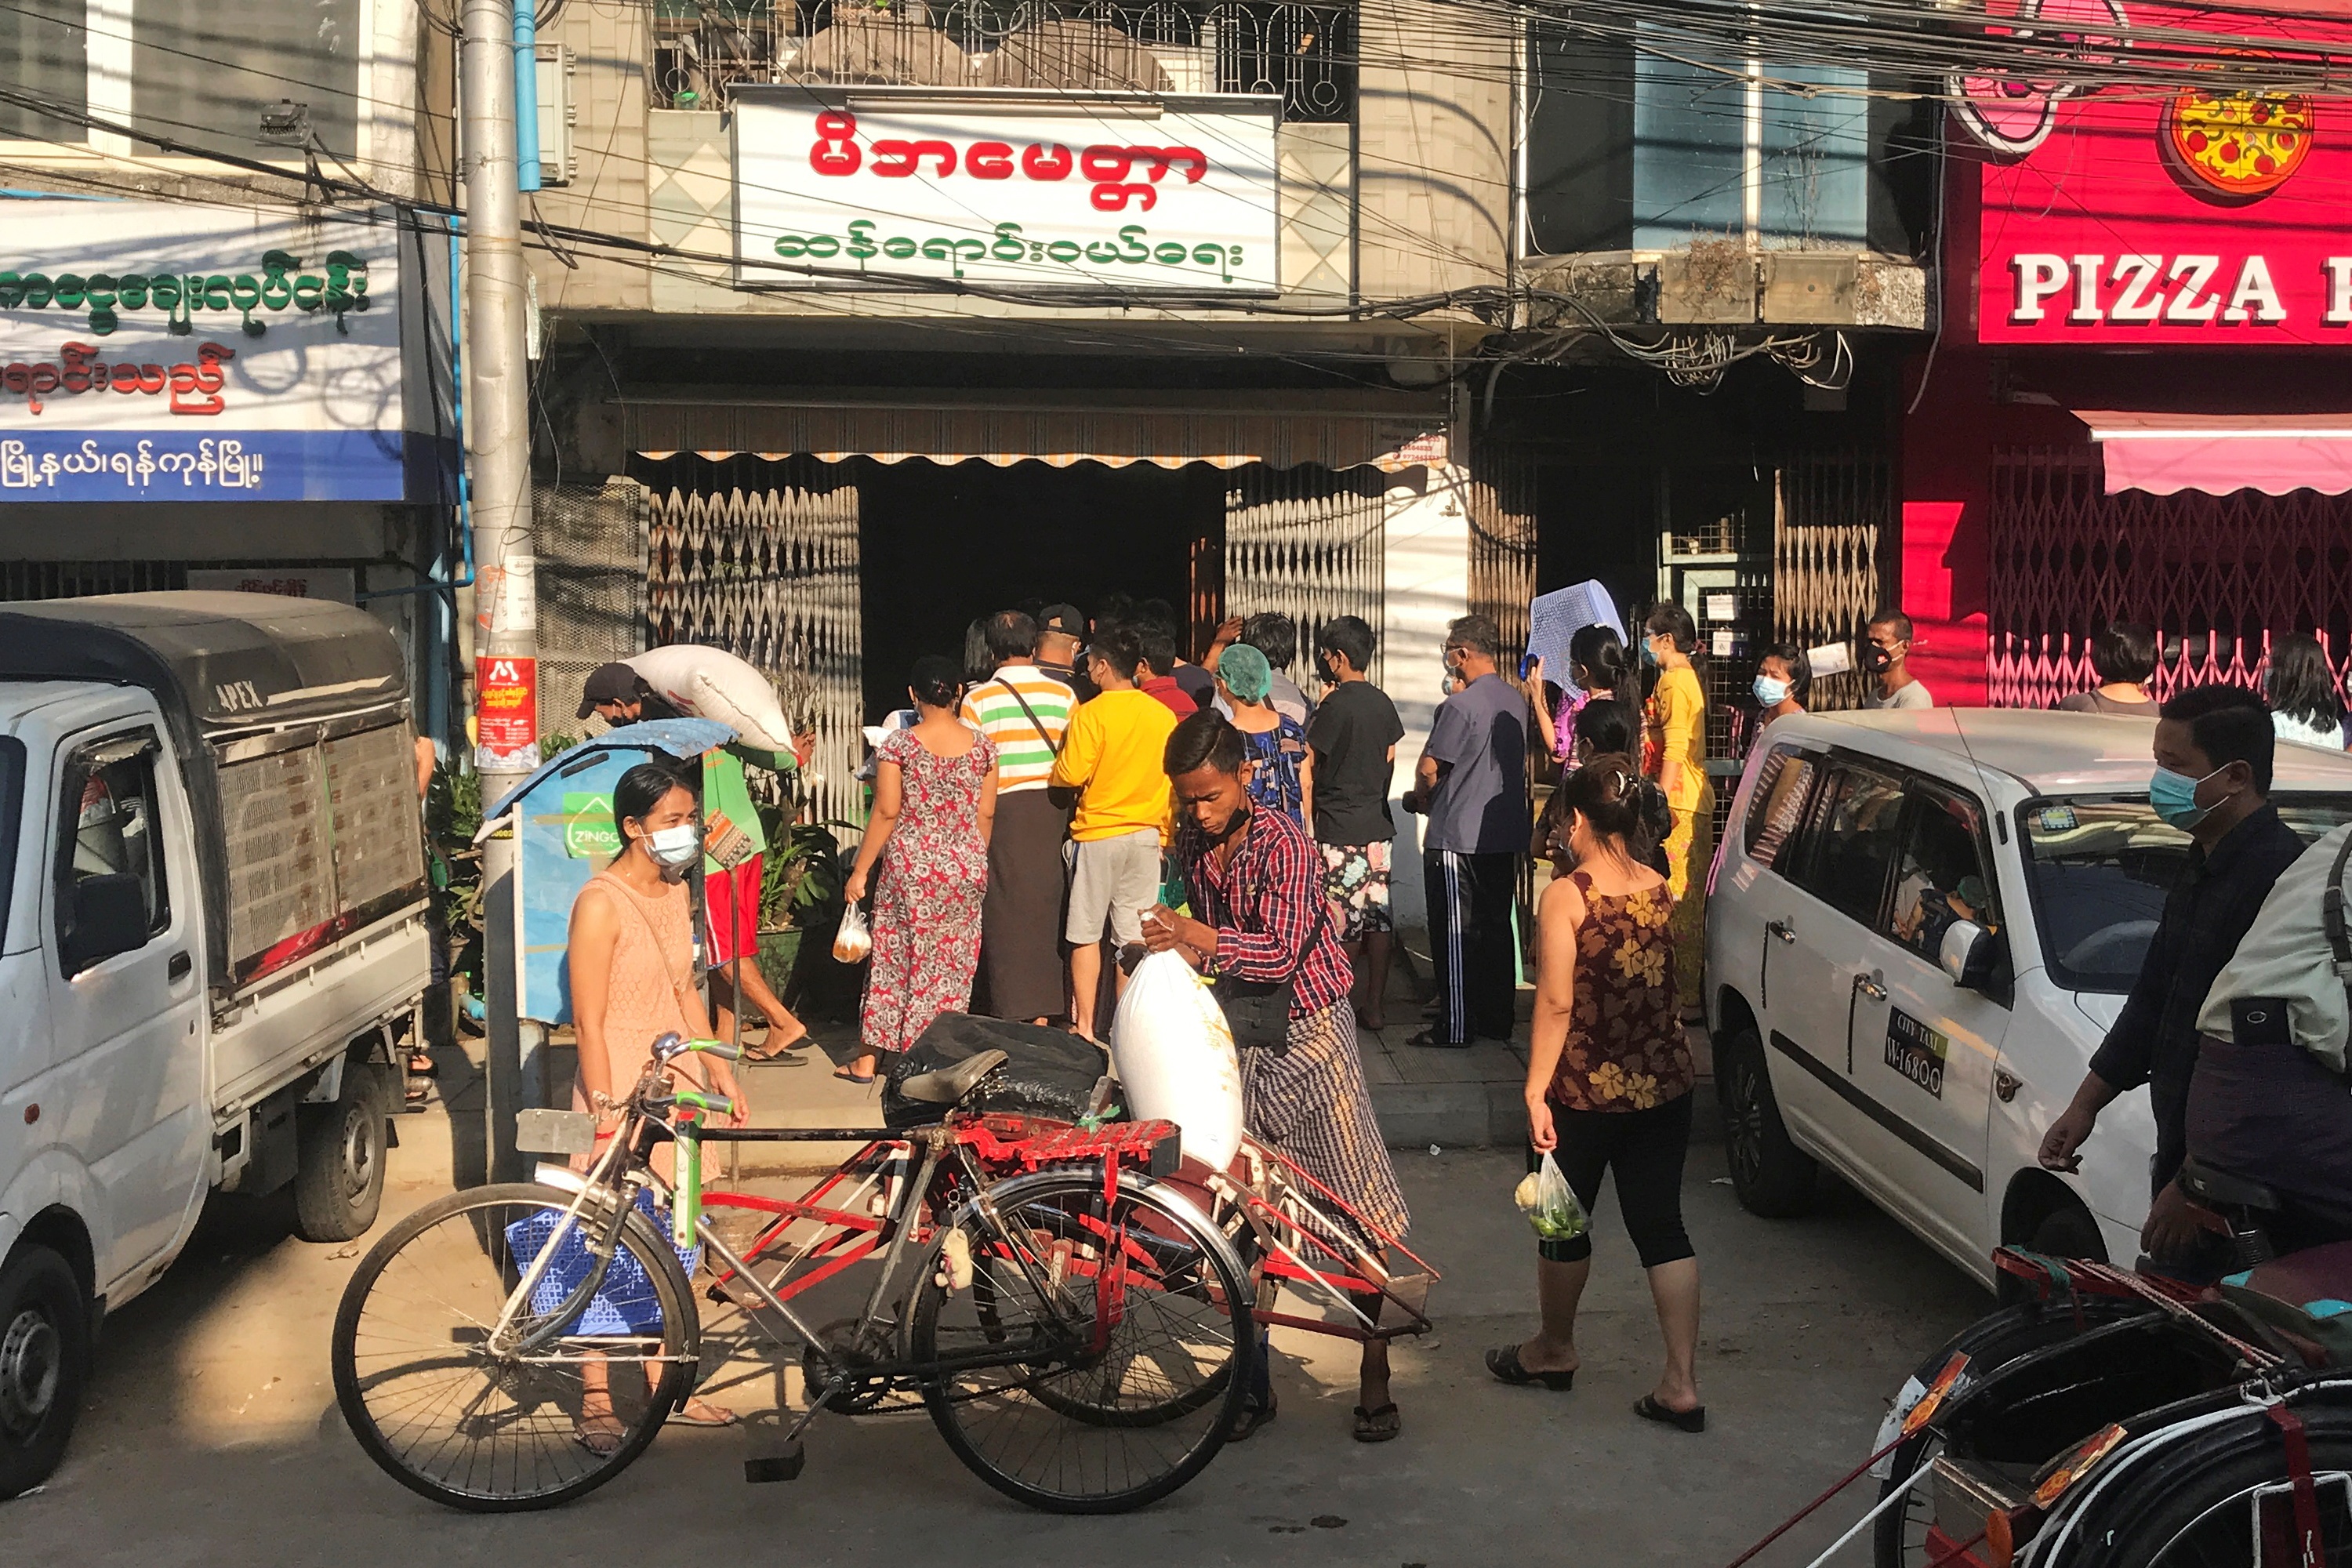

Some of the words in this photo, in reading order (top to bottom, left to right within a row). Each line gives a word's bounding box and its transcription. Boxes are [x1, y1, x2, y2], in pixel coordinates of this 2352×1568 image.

[809, 110, 1207, 212] မိဘမေတ္တာ
[773, 220, 1243, 284] ဆန်ရောင်းဝယ်ရေး
[2010, 253, 2287, 323] PIZZA
[215, 681, 263, 713] APEX
[1897, 1014, 1917, 1036] CITY
[1919, 1027, 1938, 1051] TAXI
